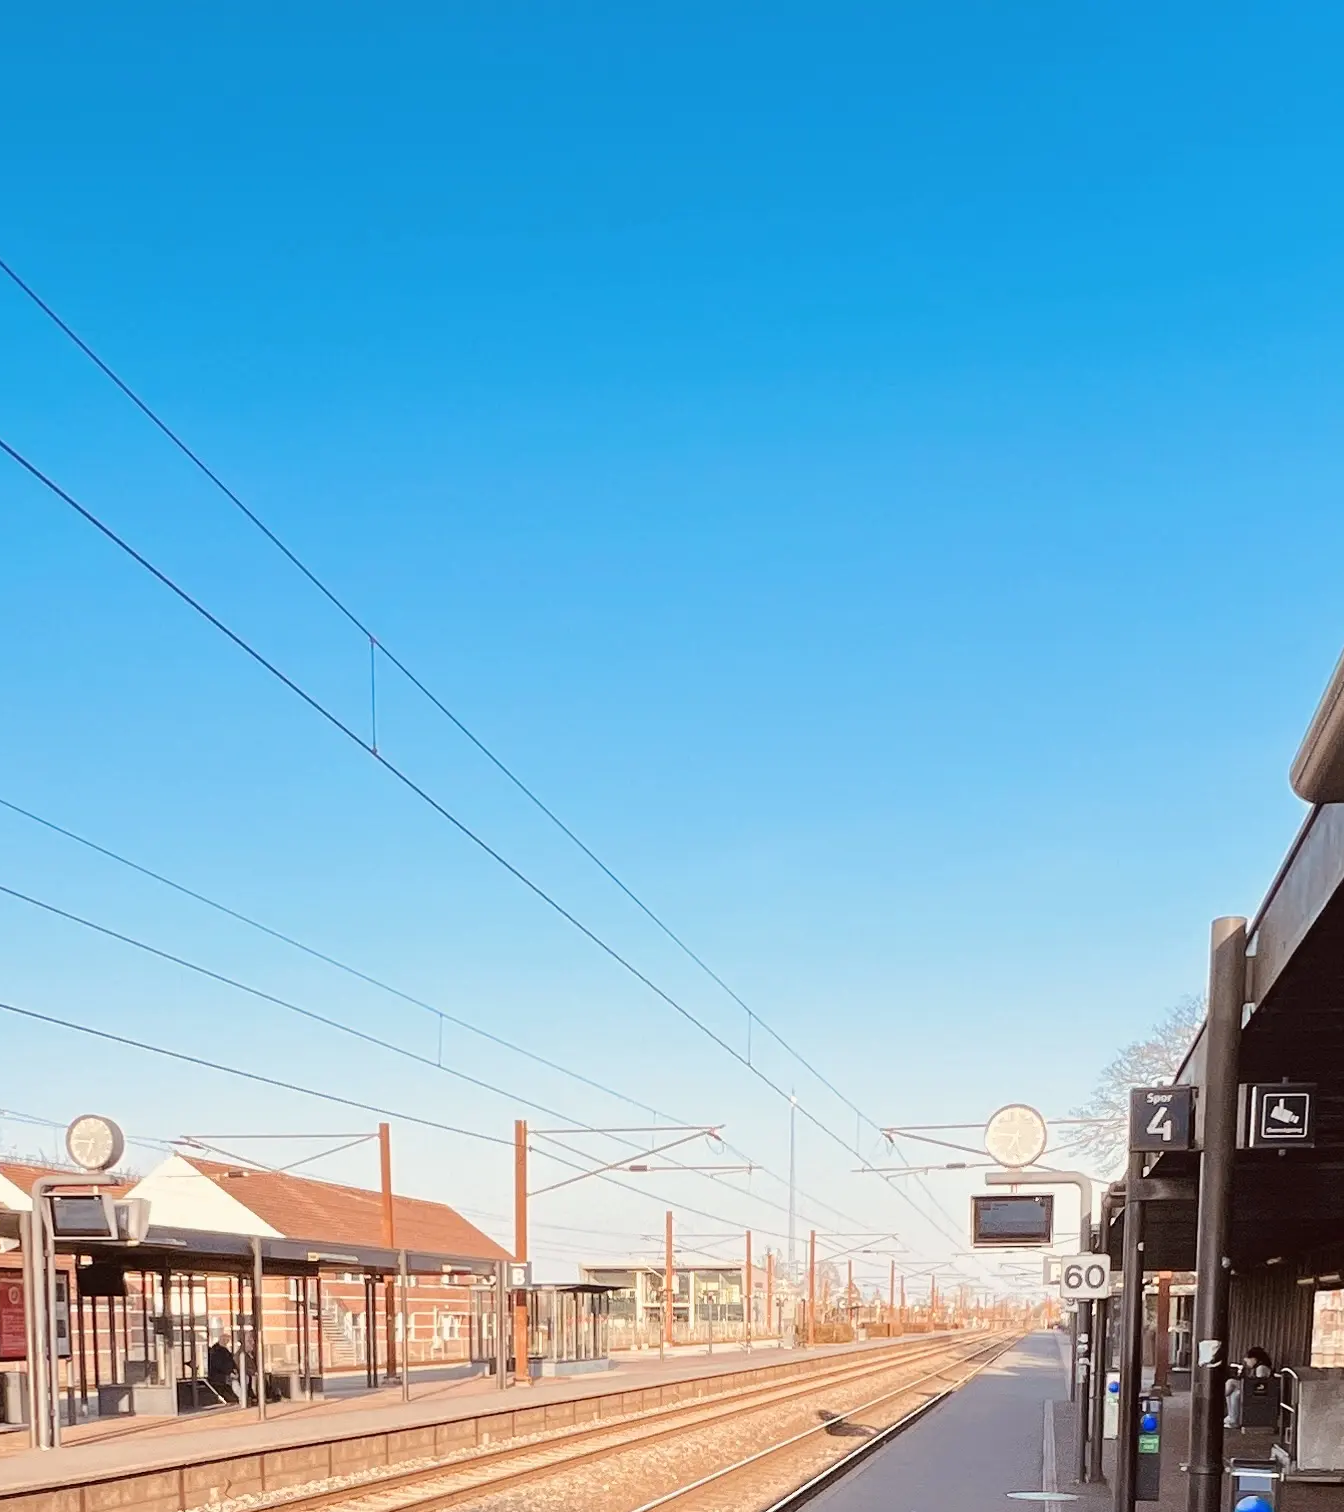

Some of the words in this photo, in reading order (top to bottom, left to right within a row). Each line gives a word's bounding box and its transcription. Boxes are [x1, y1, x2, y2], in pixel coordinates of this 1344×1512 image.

[1146, 1093, 1173, 1106] Spor
[1146, 1107, 1172, 1141] 4
[512, 1268, 525, 1285] B
[1064, 1264, 1105, 1289] 60
